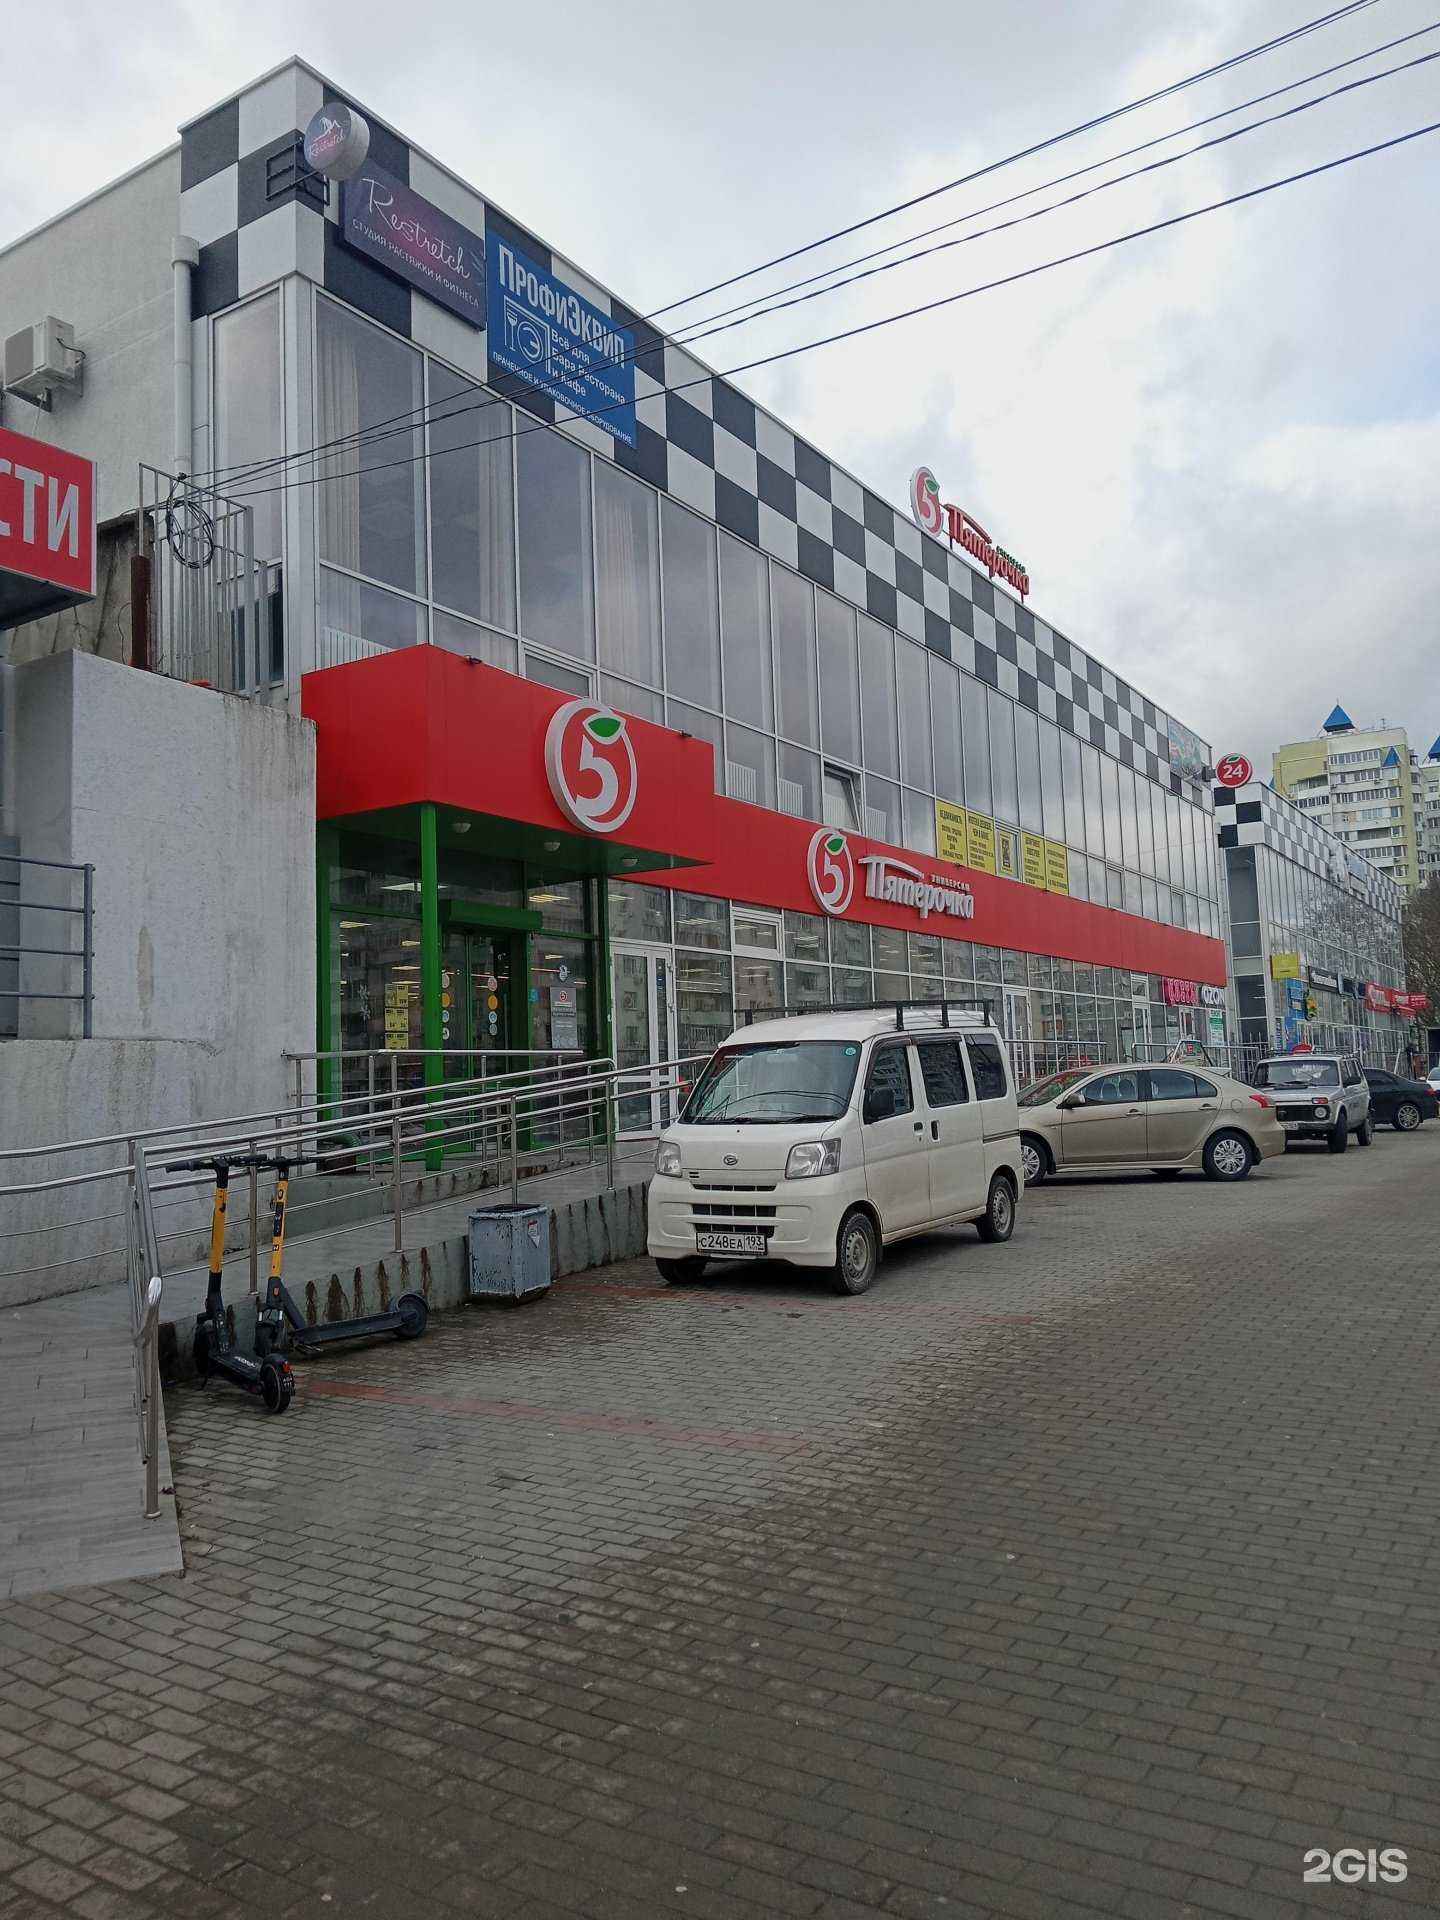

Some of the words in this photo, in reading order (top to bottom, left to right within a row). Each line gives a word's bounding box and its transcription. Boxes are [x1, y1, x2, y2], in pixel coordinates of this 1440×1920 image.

[352, 218, 387, 248] СТУДИЯ
[387, 243, 434, 279] РАСТЯЖКИ
[360, 178, 471, 279] Restretch
[498, 243, 625, 369] ПРОФИЭКВИП
[551, 347, 577, 372] Бара
[571, 346, 591, 364] для
[574, 733, 619, 817] 5
[1222, 764, 1244, 779] 24
